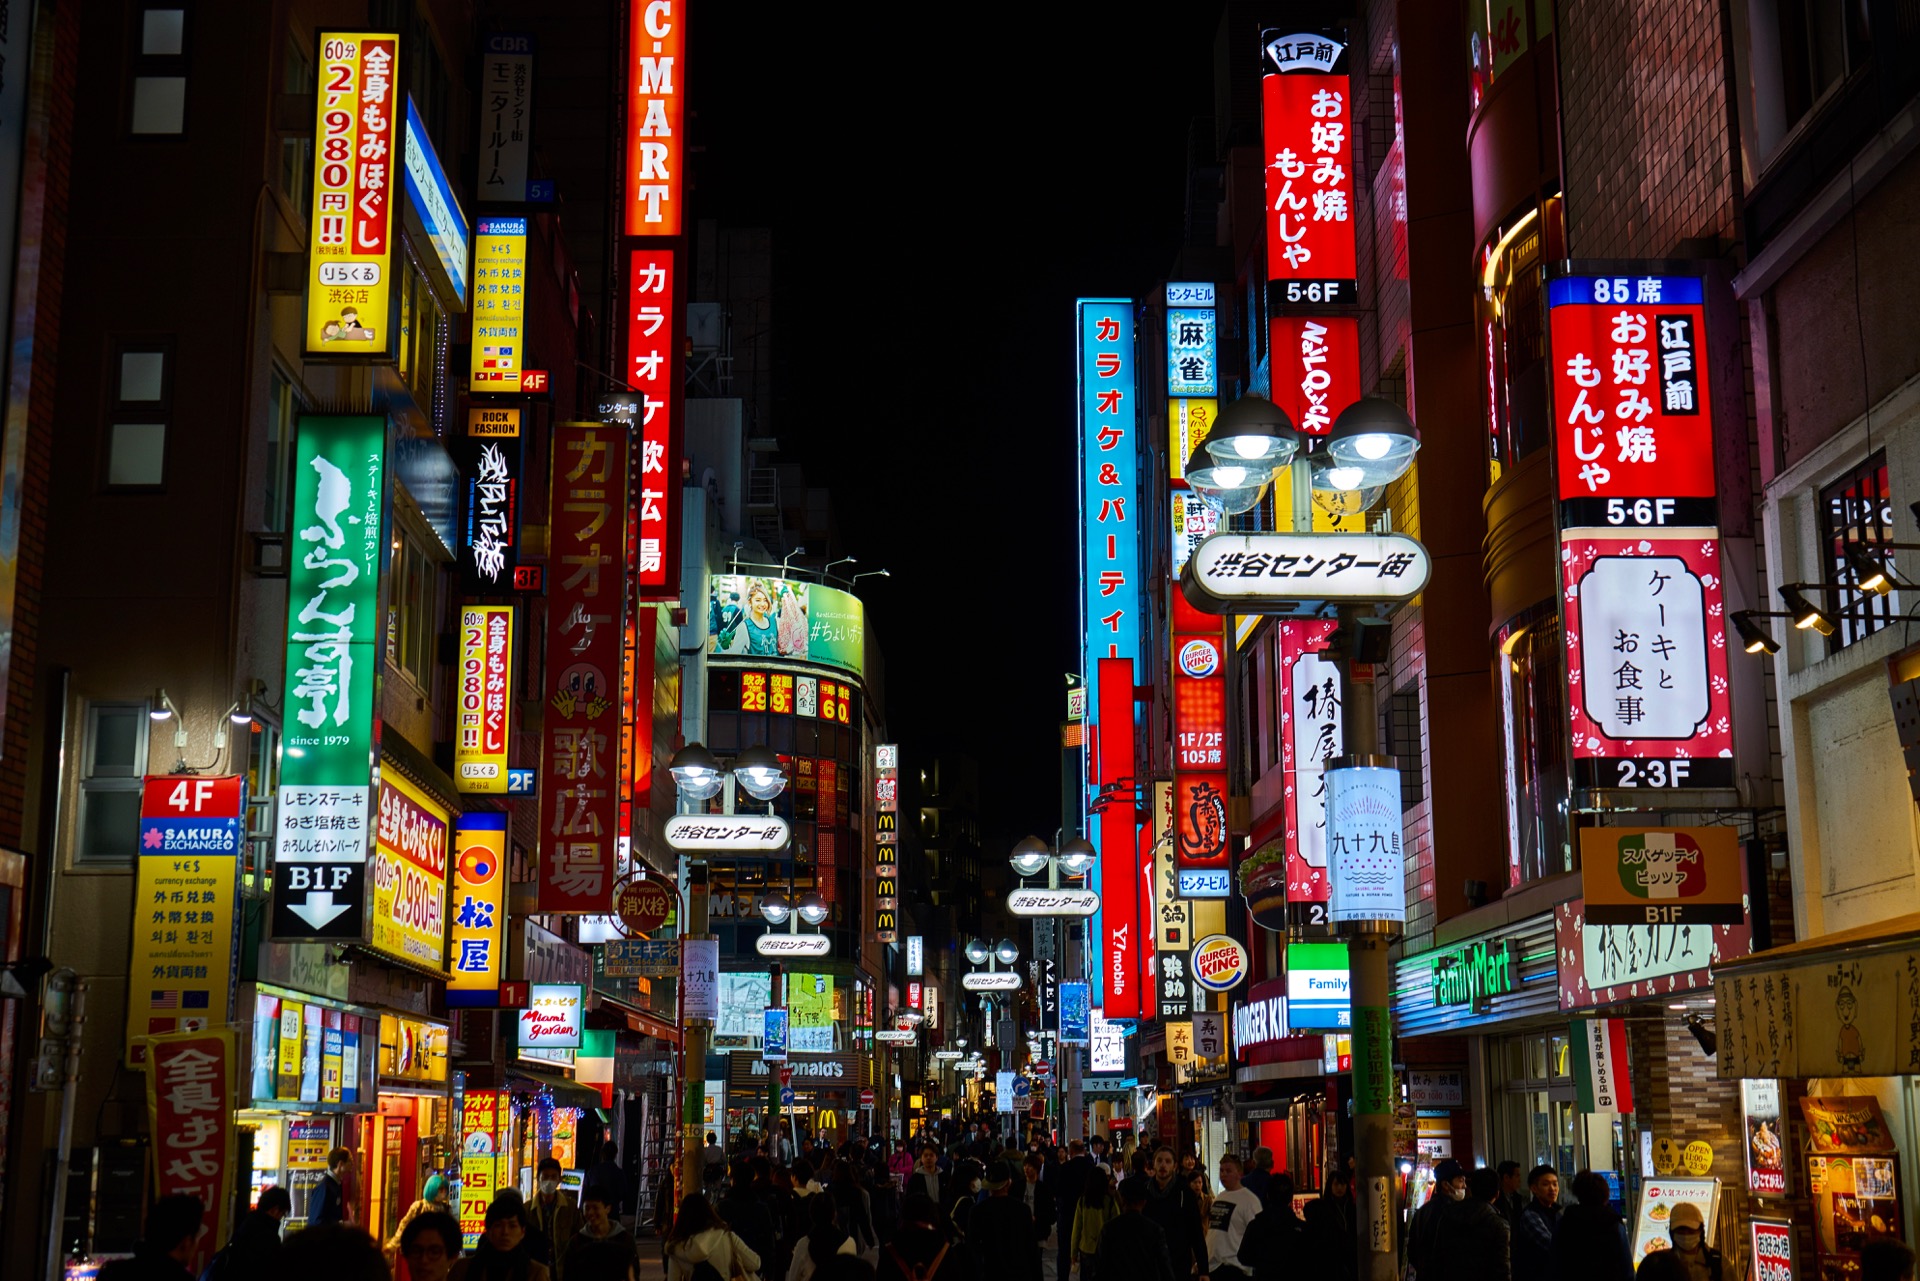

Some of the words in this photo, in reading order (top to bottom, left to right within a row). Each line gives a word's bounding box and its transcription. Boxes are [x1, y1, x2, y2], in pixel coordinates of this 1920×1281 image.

[324, 40, 356, 61] 60分
[490, 36, 529, 51] CBR
[1275, 42, 1335, 63] 江戸前
[512, 63, 528, 142] 渋谷センター街
[486, 63, 511, 186] モニタールーム
[356, 46, 392, 249] 全身もみほぐし
[1311, 88, 1347, 222] お好み焼
[1274, 148, 1311, 270] もんじゃ
[478, 257, 498, 265] currency
[500, 257, 523, 265] exchange
[323, 267, 376, 282] りらくる
[328, 288, 370, 305] 渋谷店
[1167, 287, 1214, 301] センタービル
[1594, 277, 1662, 303] 85席
[476, 299, 496, 310] 외화
[502, 299, 521, 310] 환전
[1200, 310, 1214, 320] 5F
[478, 327, 518, 337] 外貨両替
[1178, 321, 1205, 383] 麻雀
[1661, 319, 1693, 411] 江戸前
[523, 374, 545, 389] 4F
[1611, 310, 1657, 463] お好み焼
[598, 402, 637, 414] センター街
[482, 412, 508, 423] ROCK
[1567, 353, 1611, 492] もんじゃ
[474, 423, 515, 434] FASHION
[364, 454, 380, 576] ステーキと焙煎カレー
[1207, 552, 1416, 578] 渋谷センター街
[518, 570, 538, 586] 3F
[463, 612, 484, 626] 60分
[1648, 570, 1677, 689] ケーキと
[1185, 649, 1211, 661] BURGER
[1186, 655, 1213, 670] KING
[486, 615, 508, 750] 全身もみほぐし
[1613, 629, 1645, 725] お食事
[290, 735, 320, 746] since
[323, 735, 350, 746] 1979
[1181, 750, 1221, 764] 105席
[464, 765, 496, 776] りらくる
[469, 781, 489, 790] 渋谷店
[509, 773, 533, 791] 2F
[169, 780, 214, 812] 4F
[285, 792, 363, 807] レモンステーキ
[285, 815, 361, 830] ねぎ塩焼き
[380, 787, 444, 872] 全身もみほぐし
[165, 829, 234, 840] SAKURA
[670, 826, 783, 841] 渋谷センター街
[283, 839, 361, 854] おろししそハンバーグ
[1333, 830, 1400, 856] 九十九島
[1623, 848, 1699, 865] スパゲッティ
[289, 866, 353, 890] B1F
[375, 852, 393, 892] 60分
[1636, 871, 1688, 887] ピッツァ
[154, 877, 184, 886] currency
[185, 877, 217, 886] exchange
[1179, 876, 1228, 891] センタービル
[623, 896, 665, 917] 消火栓
[1014, 896, 1096, 908] 渋谷センター街
[1646, 906, 1682, 923] B1F
[150, 931, 178, 944] 외화
[186, 931, 213, 944] 환전
[456, 896, 494, 973] 松屋
[625, 942, 679, 958] セキネ
[760, 940, 826, 950] 渋谷センター街
[1112, 923, 1128, 995] Y!mobile
[1199, 947, 1238, 965] BURGER
[152, 965, 207, 979] 外貨両替
[1201, 955, 1240, 978] KING
[965, 976, 1018, 985] 渋谷センター街
[1431, 939, 1511, 1014] FamilyMart
[506, 985, 525, 1003] 1F
[521, 1010, 567, 1023] Miami
[1163, 1004, 1187, 1015] B1F
[1238, 1000, 1268, 1047] BURGER
[1201, 1018, 1217, 1053] 寿司
[1174, 1028, 1189, 1061] 寿司
[1688, 1144, 1711, 1154] OPEN
[1689, 1162, 1708, 1171] 23:30
[1759, 1175, 1785, 1188] こてがえし
[1661, 1188, 1709, 1197] 人気スパゲッティ
[1757, 1232, 1790, 1258] お好み焼
